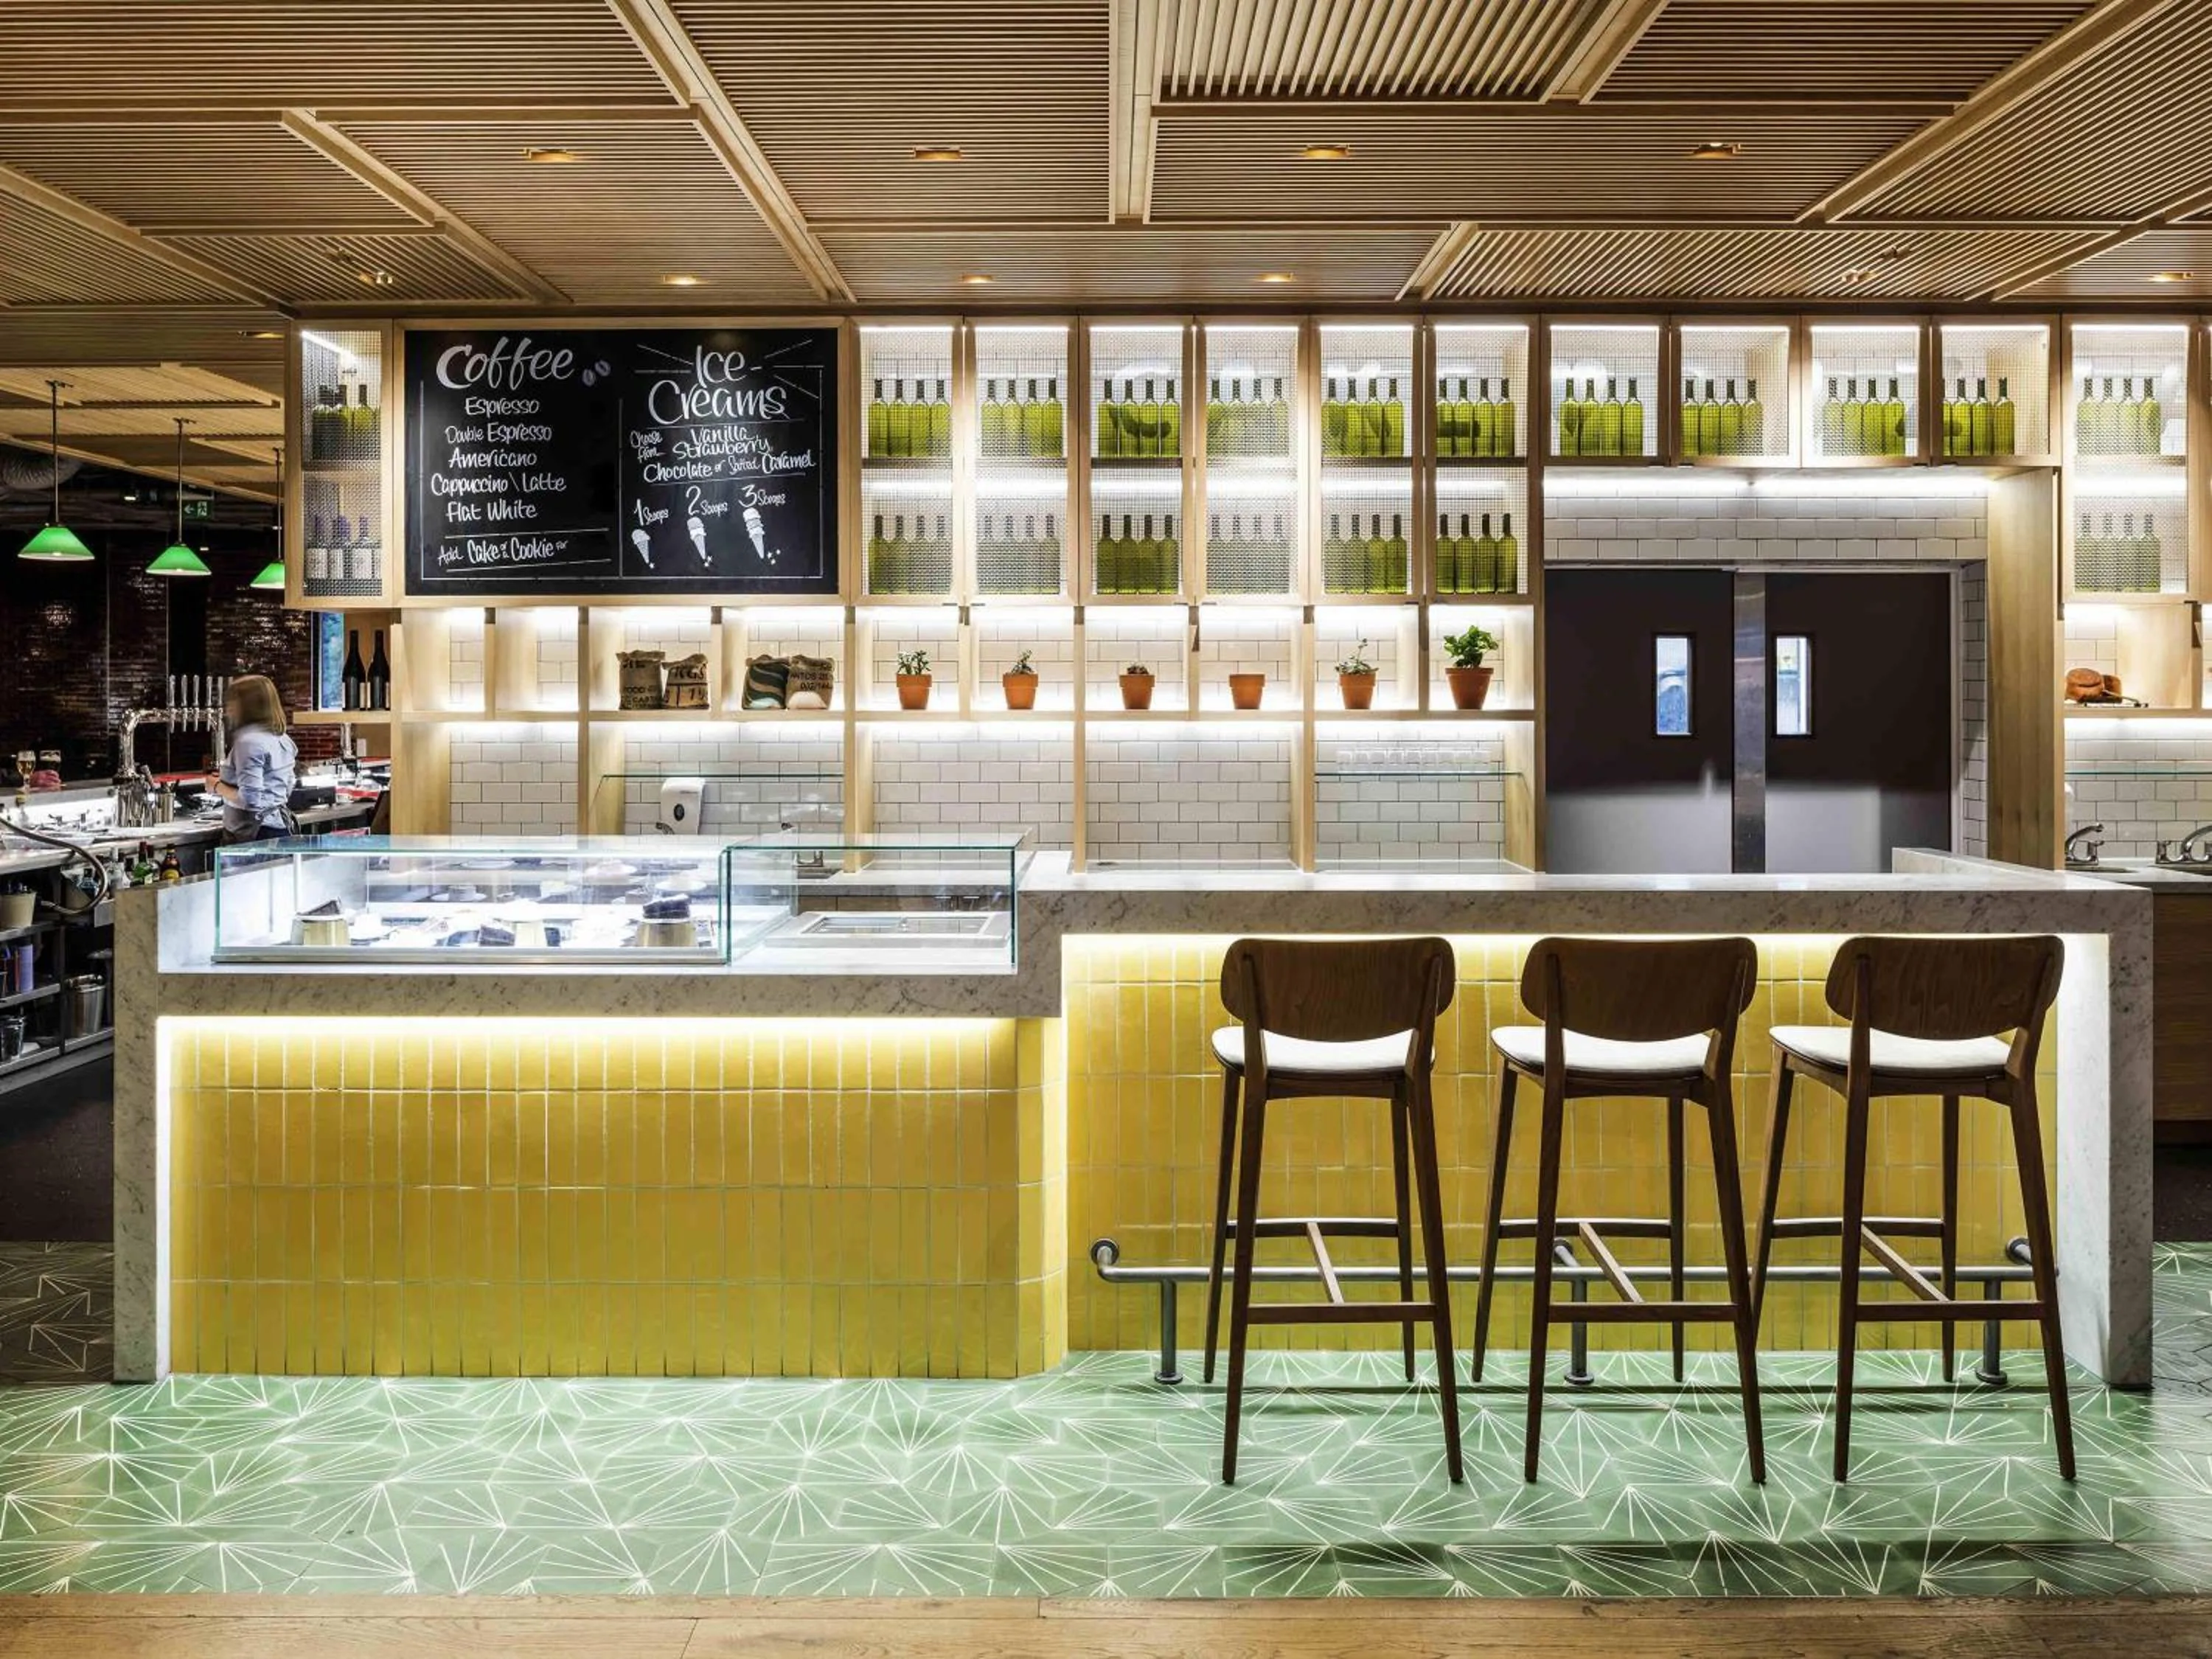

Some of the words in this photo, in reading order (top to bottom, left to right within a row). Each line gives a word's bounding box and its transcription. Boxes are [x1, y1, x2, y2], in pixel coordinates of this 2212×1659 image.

[437, 337, 574, 389] Coffee
[465, 397, 539, 417] Espresso
[649, 380, 790, 425] Creams
[445, 425, 484, 444] Double
[487, 422, 552, 444] Espresso
[449, 447, 537, 468] Americano
[644, 462, 713, 482] Chocolate
[714, 459, 726, 472] or
[728, 456, 761, 475] Salted
[762, 450, 816, 473] Caramel
[431, 473, 508, 495] Cappuccino
[523, 473, 566, 493] Latte
[738, 484, 757, 507] 3
[446, 501, 481, 522] Flat
[487, 498, 538, 521] White
[686, 485, 701, 515] 2
[438, 545, 463, 566] Add
[467, 539, 500, 563] Cake
[511, 537, 554, 561] Cookie
